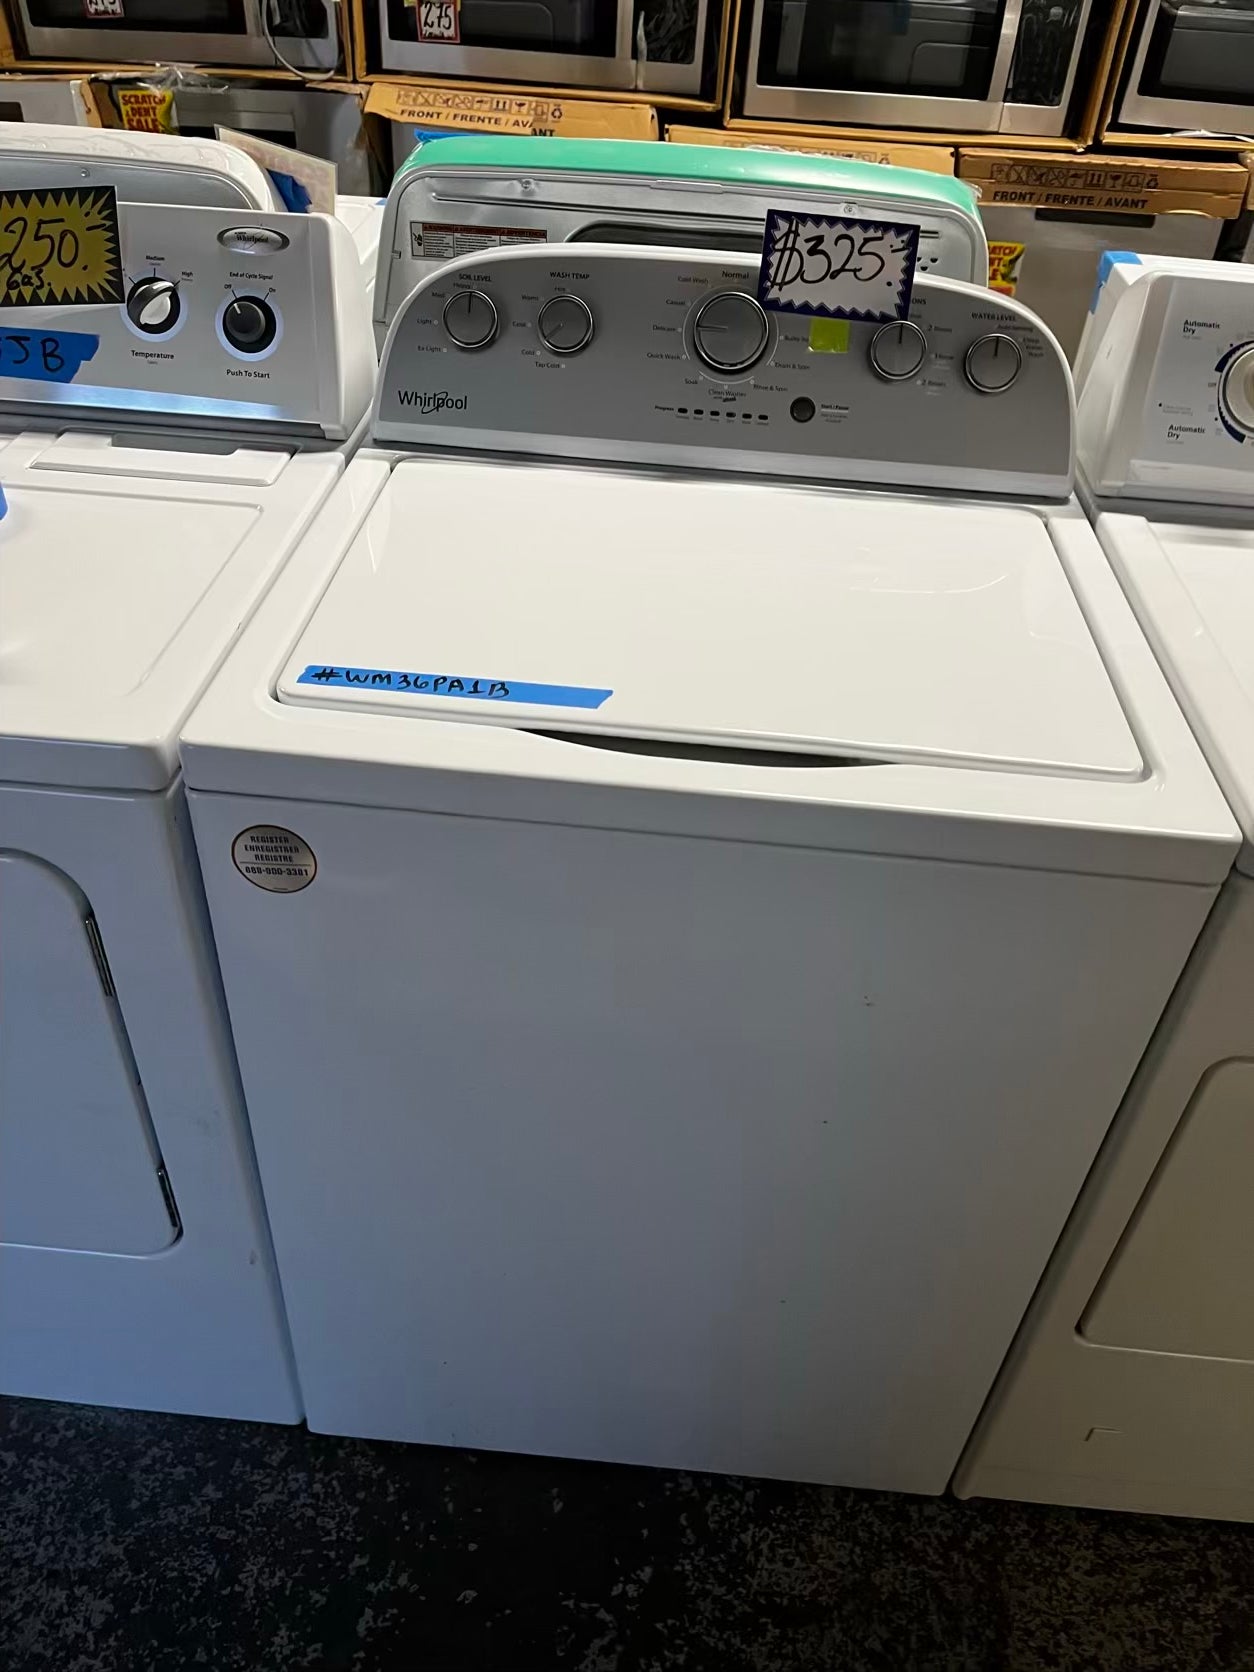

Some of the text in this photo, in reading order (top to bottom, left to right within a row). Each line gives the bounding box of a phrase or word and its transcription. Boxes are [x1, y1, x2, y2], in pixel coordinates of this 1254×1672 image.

[424, 1, 452, 30] 275
[121, 94, 167, 106] SCRATCH
[130, 106, 157, 117] DENT
[400, 109, 443, 120] FRONT
[453, 113, 502, 126] FRENTE
[127, 118, 161, 132] SALE
[993, 190, 1036, 202] FRONT
[1044, 191, 1096, 207] FRENTE
[1104, 197, 1148, 209] AVANT
[236, 235, 270, 245] Whirlpool
[458, 273, 492, 282] SOIL LEVEL
[549, 271, 591, 280] WASH TEMP
[721, 270, 750, 280] Normal
[971, 312, 1016, 322] WATER LEVEL
[1184, 319, 1221, 329] Automatic
[1183, 326, 1196, 334] Dry
[131, 350, 175, 360] Temperature
[226, 368, 270, 379] Push To Start
[397, 390, 468, 413] Whirlpool
[1168, 424, 1206, 434] Automatic
[1167, 431, 1181, 440] Dry
[250, 835, 290, 844] REGISTER
[244, 844, 300, 853] ENREGISTRER
[254, 854, 294, 862] REGISTRE
